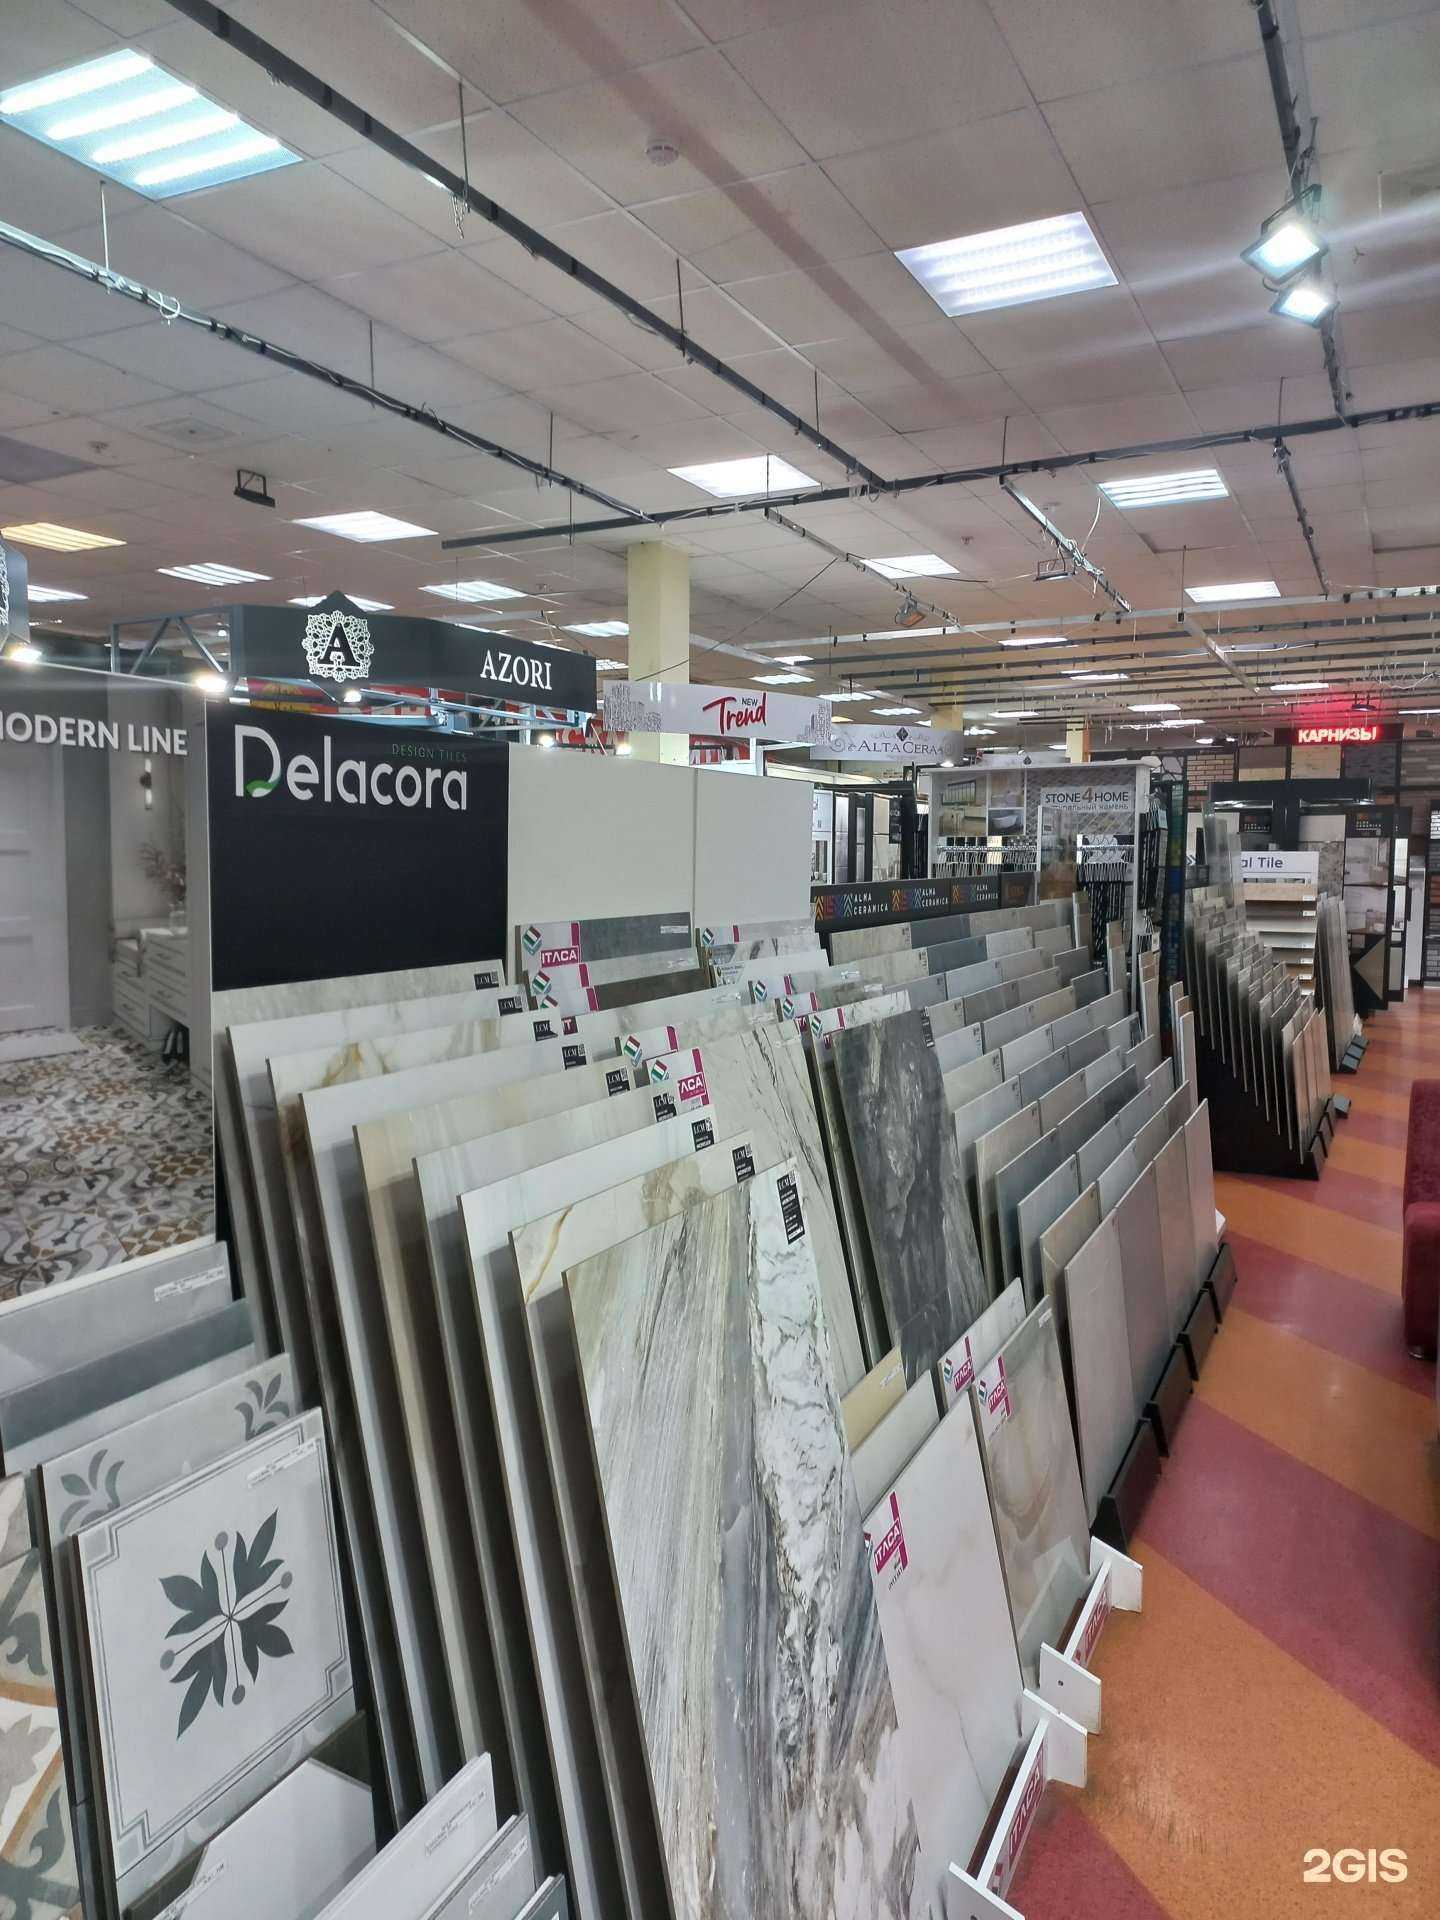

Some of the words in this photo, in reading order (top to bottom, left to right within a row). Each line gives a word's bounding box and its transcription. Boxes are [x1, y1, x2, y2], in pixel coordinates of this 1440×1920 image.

[480, 649, 553, 690] AZORI
[741, 697, 758, 707] NEW
[702, 692, 767, 735] Trend
[0, 710, 119, 750] ODERN
[128, 724, 188, 755] LINE
[1298, 726, 1377, 743] КАРНИЗЫ
[392, 743, 434, 759] DESIGN
[439, 749, 467, 762] TILES
[234, 724, 468, 811] Delacora
[1257, 857, 1284, 868] Tile
[853, 893, 872, 902] ALMA
[921, 888, 936, 896] ALMA
[853, 904, 888, 916] CERAMICA
[921, 897, 949, 908] CERAMICA
[541, 950, 577, 964] ITACA
[678, 1077, 704, 1093] ACA
[954, 1361, 972, 1386] ITACA
[875, 1525, 900, 1565] ITACA
